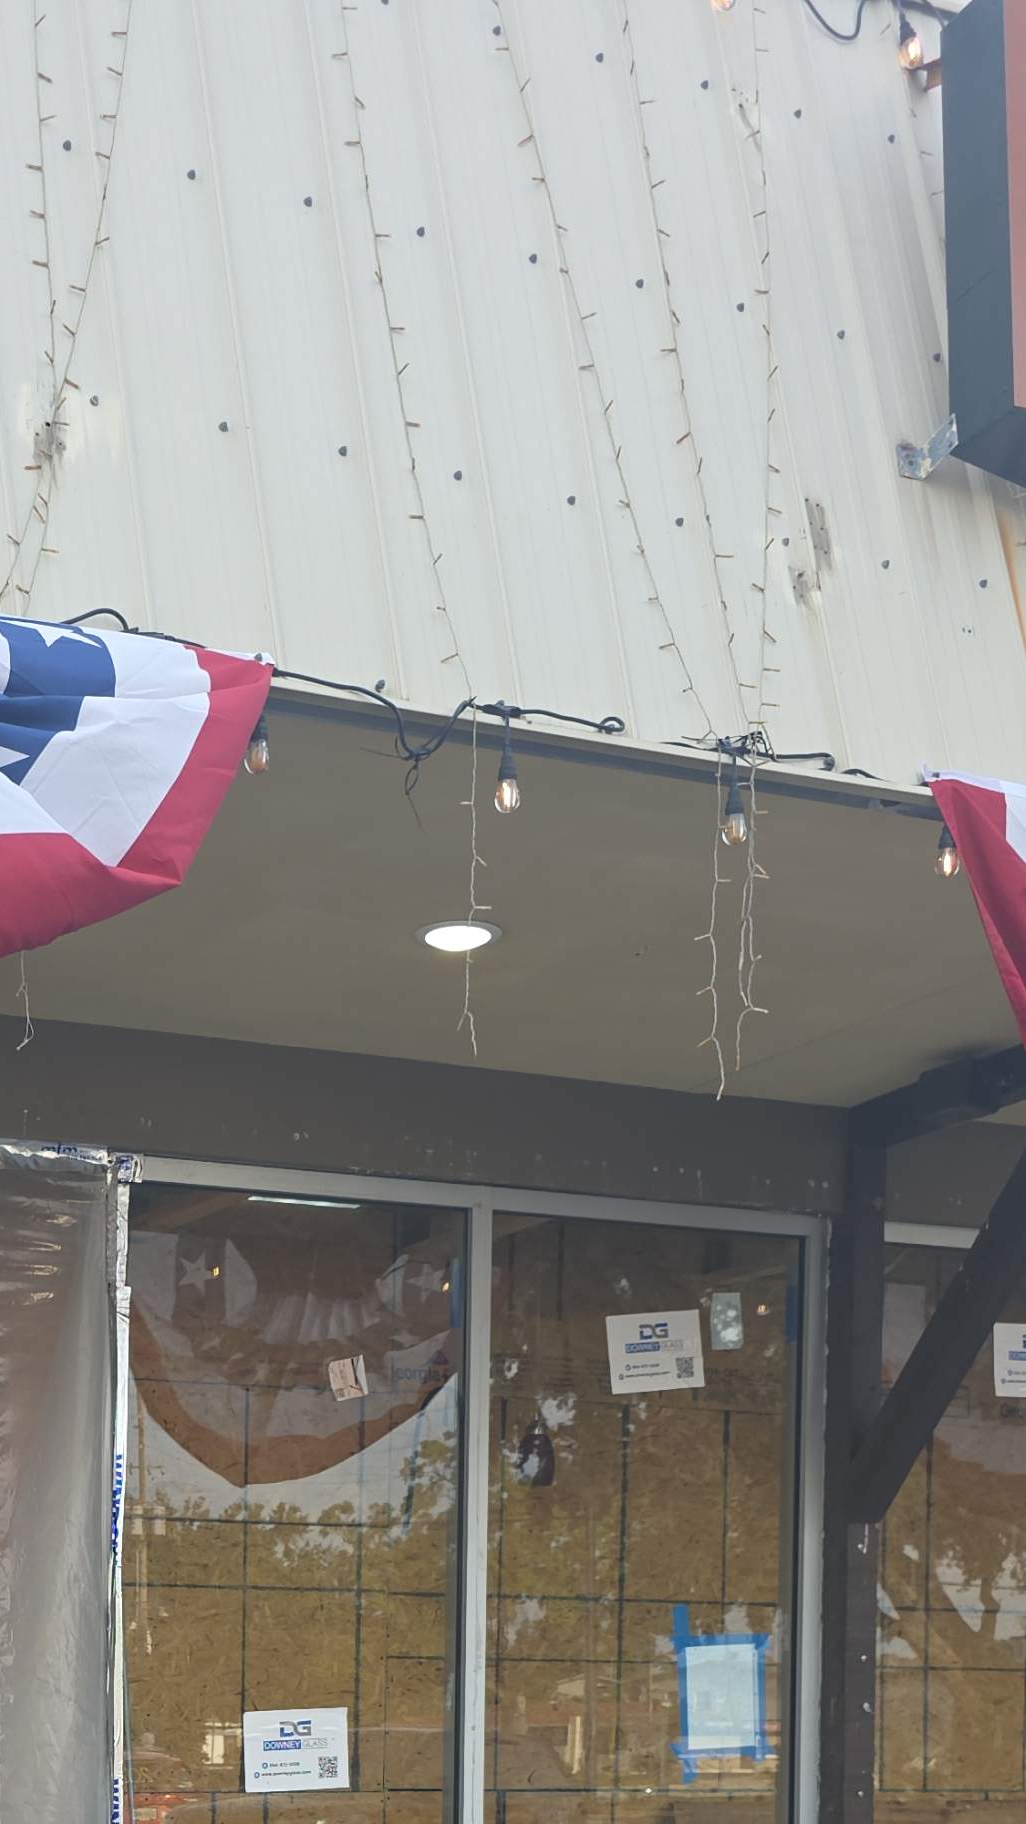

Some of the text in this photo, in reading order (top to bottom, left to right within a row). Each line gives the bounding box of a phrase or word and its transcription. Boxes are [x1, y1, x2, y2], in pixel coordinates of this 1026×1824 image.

[639, 1323, 669, 1340] DG
[279, 1720, 312, 1738] DG
[263, 1740, 302, 1751] DOWNEY
